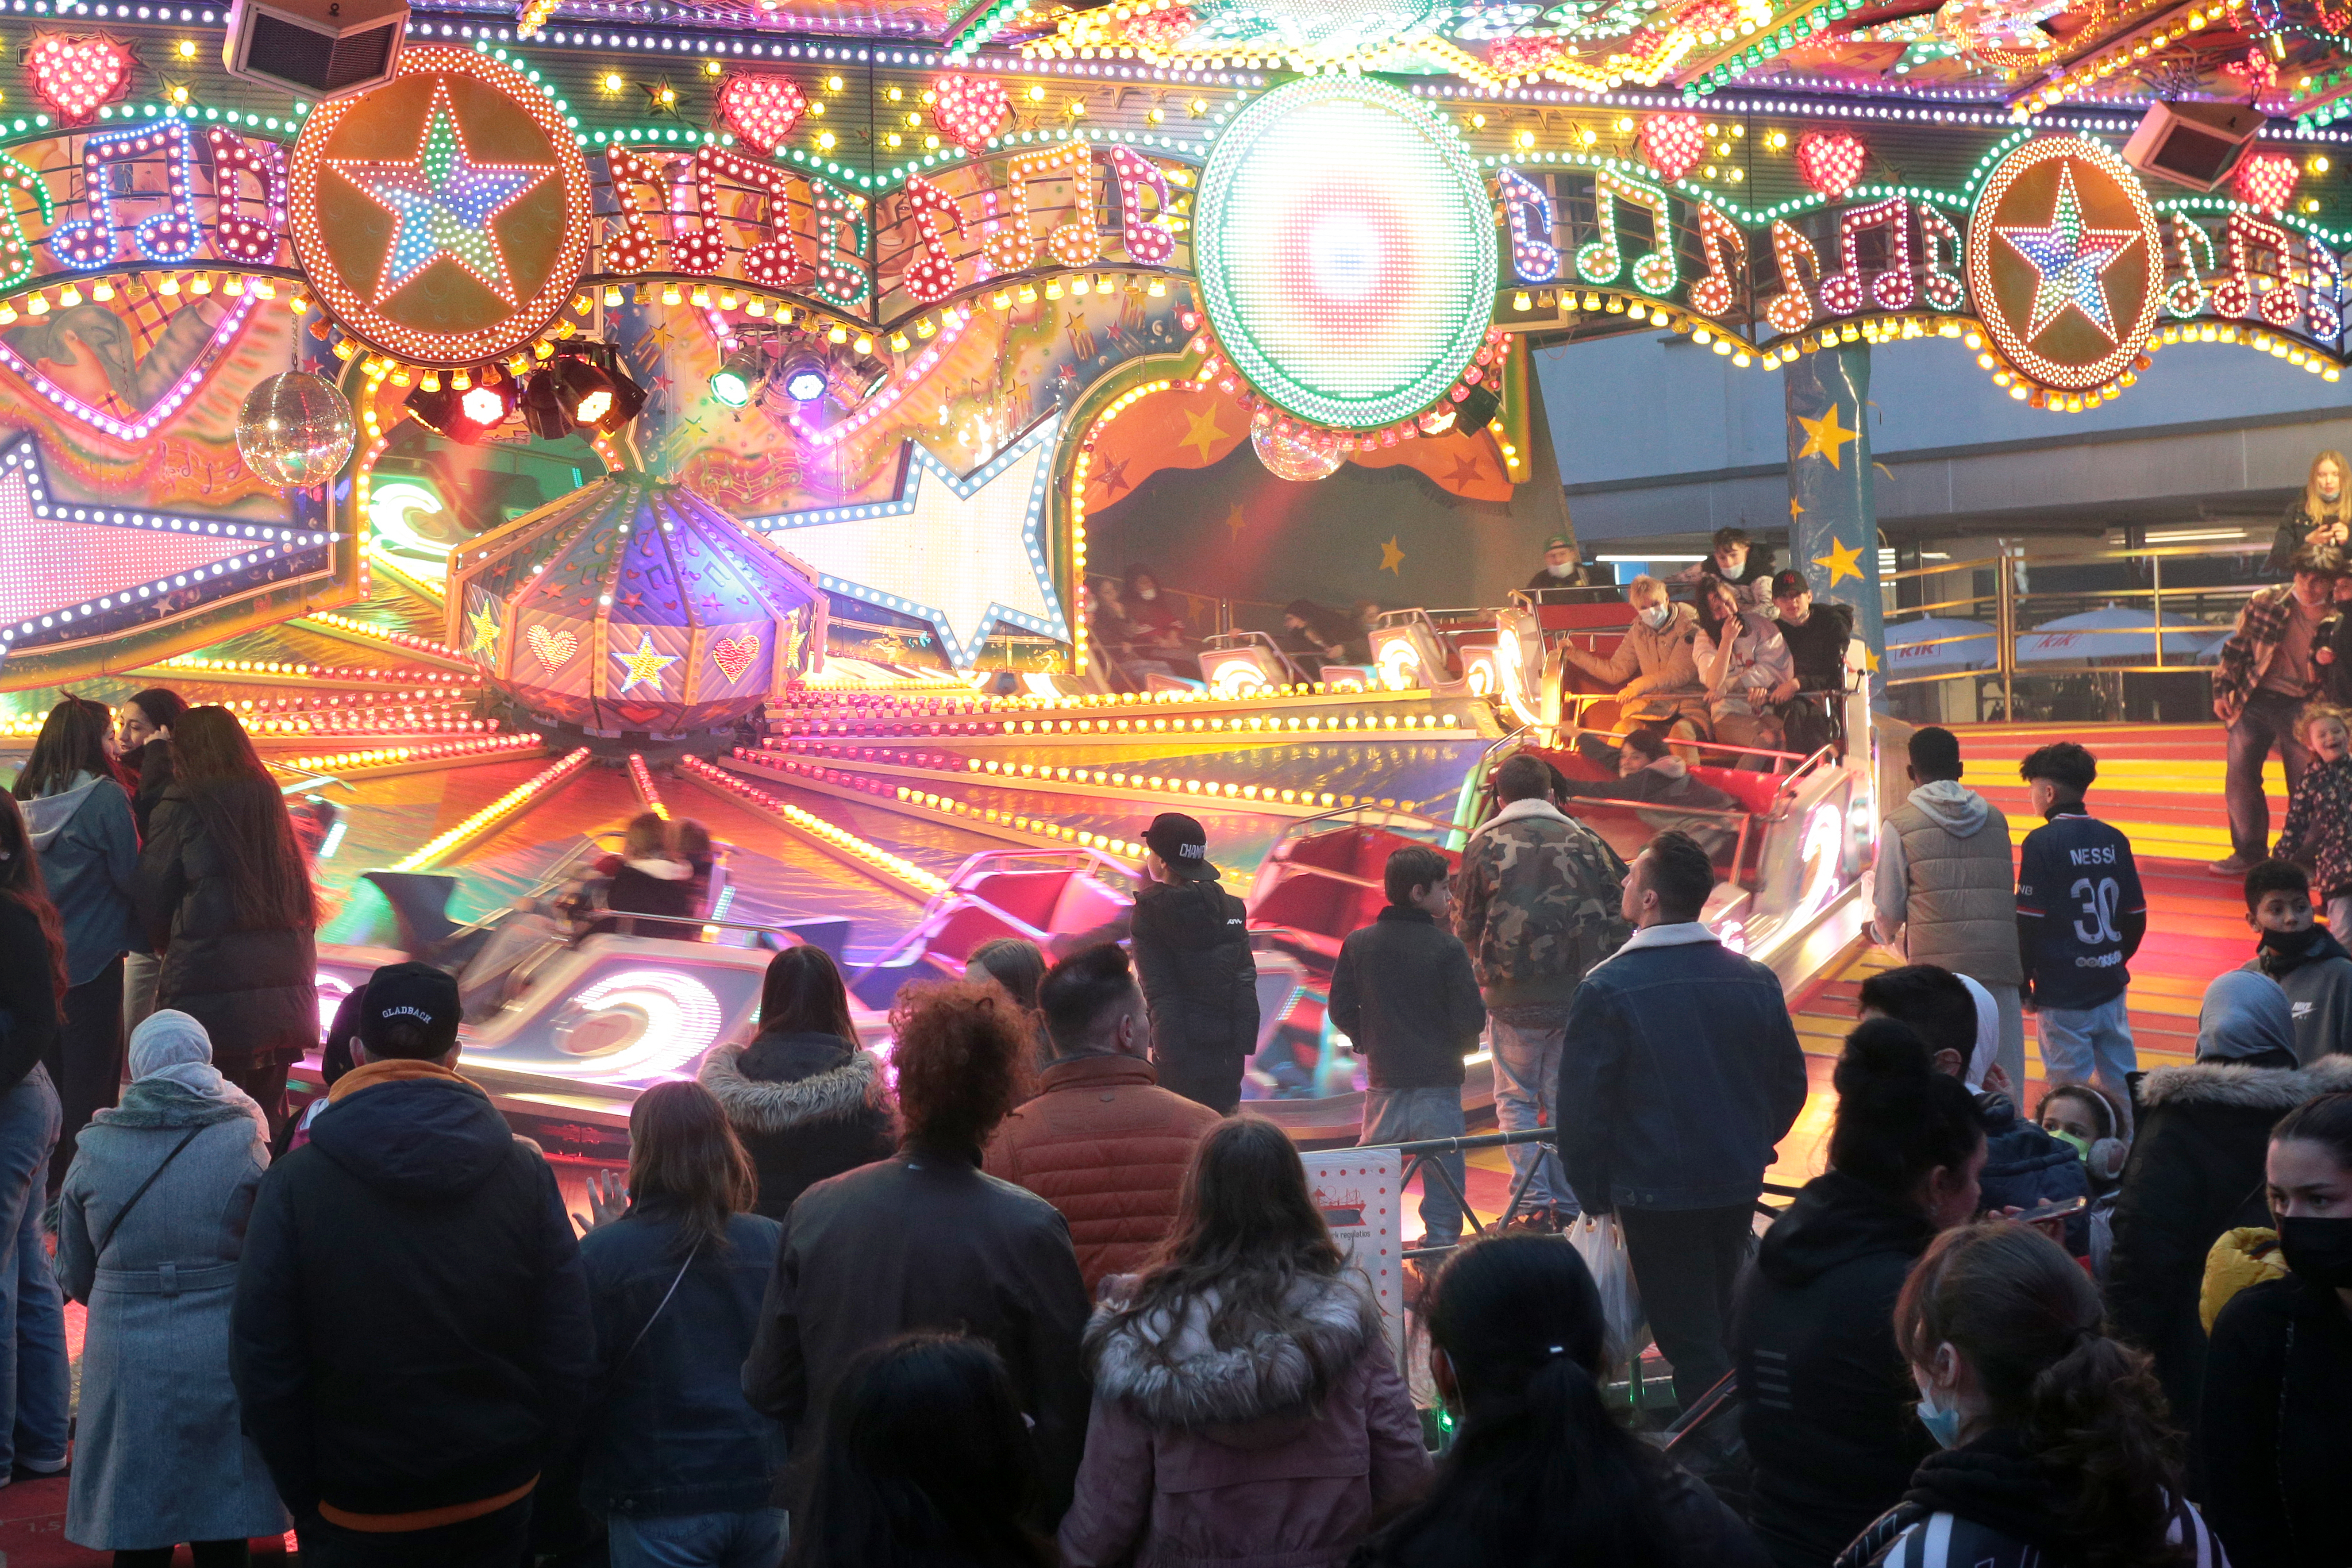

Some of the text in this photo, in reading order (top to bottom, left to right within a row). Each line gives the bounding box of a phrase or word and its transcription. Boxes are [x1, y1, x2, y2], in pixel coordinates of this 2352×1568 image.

[2017, 884, 2033, 895] NB
[2071, 877, 2122, 944] 30
[382, 1006, 432, 1025] GLADBACH
